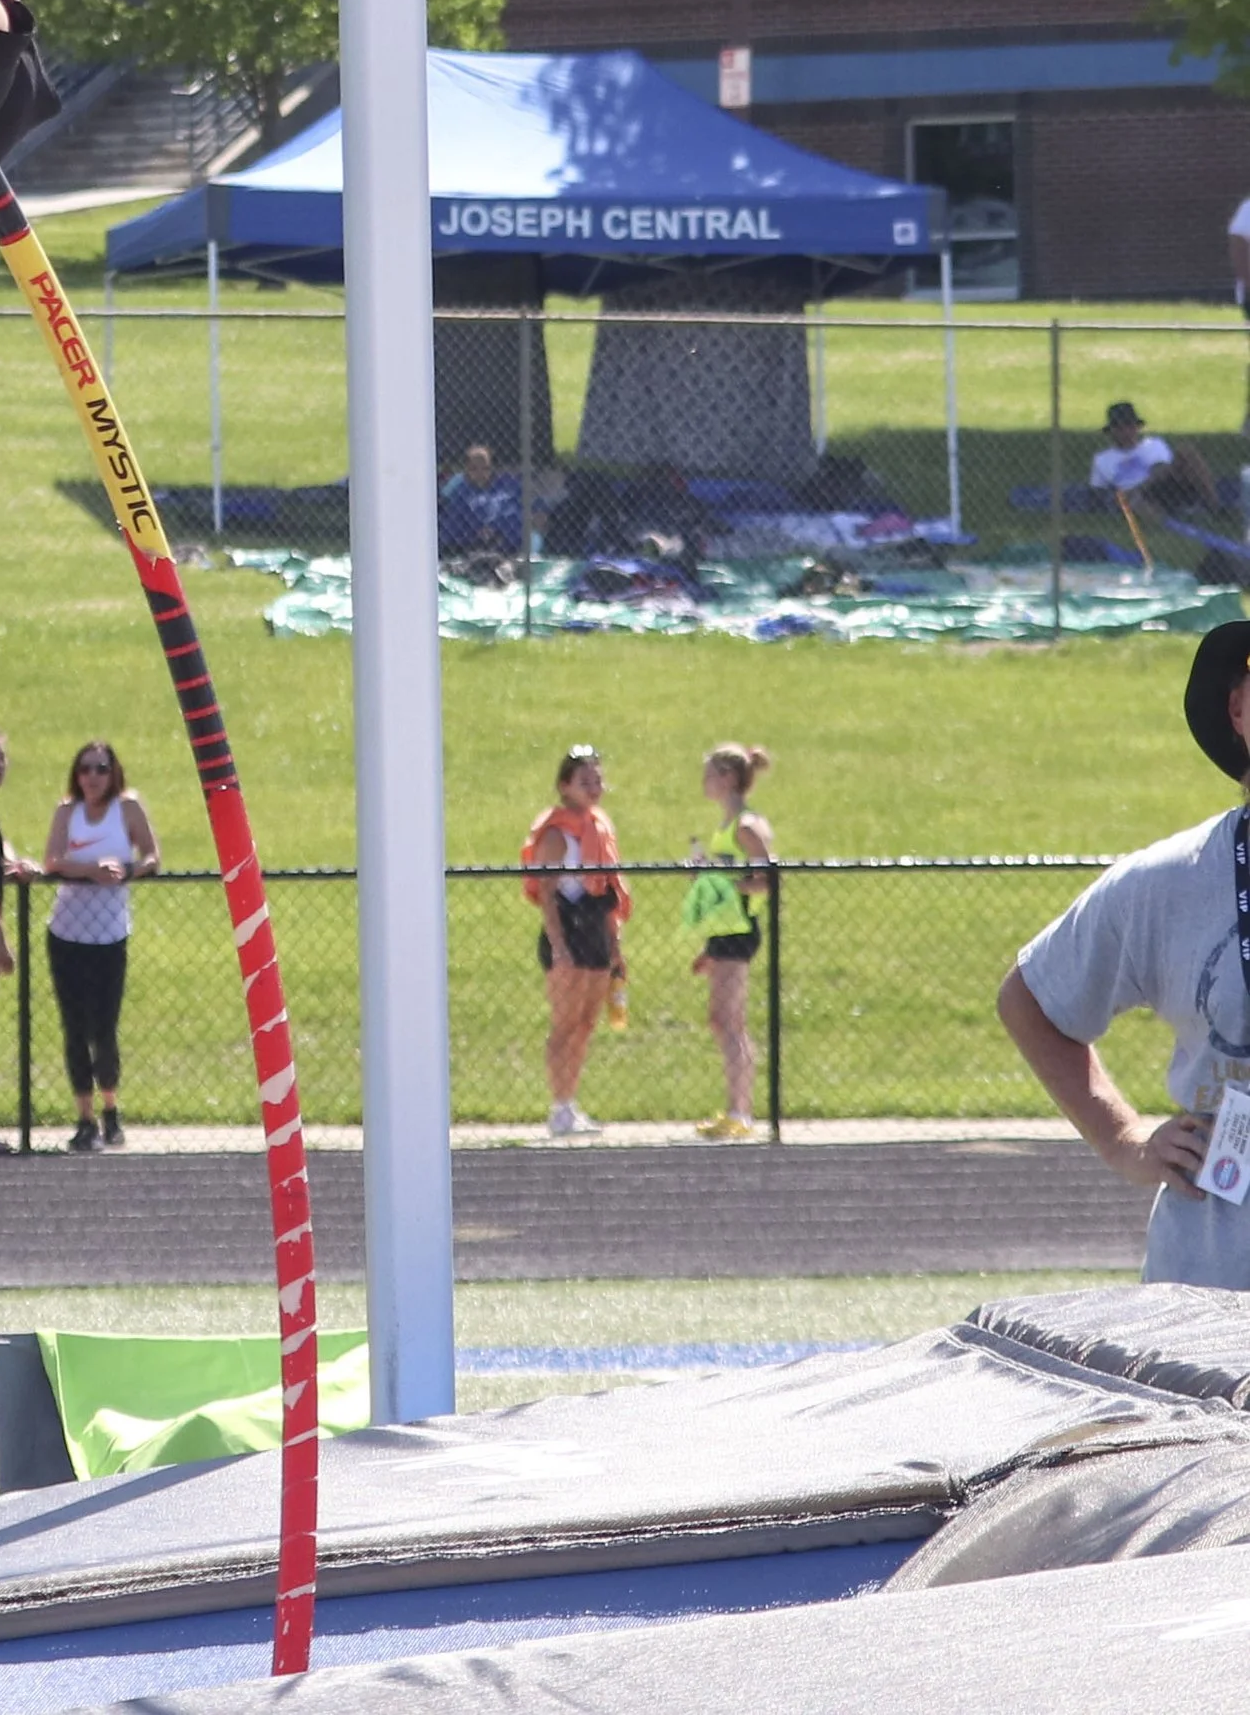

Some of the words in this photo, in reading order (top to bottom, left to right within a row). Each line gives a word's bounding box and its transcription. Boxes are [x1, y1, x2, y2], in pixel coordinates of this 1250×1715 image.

[438, 203, 591, 239] JOSEPH
[601, 207, 781, 241] CENTRAL
[28, 270, 98, 390] PACER
[85, 397, 158, 534] MYSTIC
[1236, 842, 1246, 865] VIP
[1238, 890, 1248, 913] VIP
